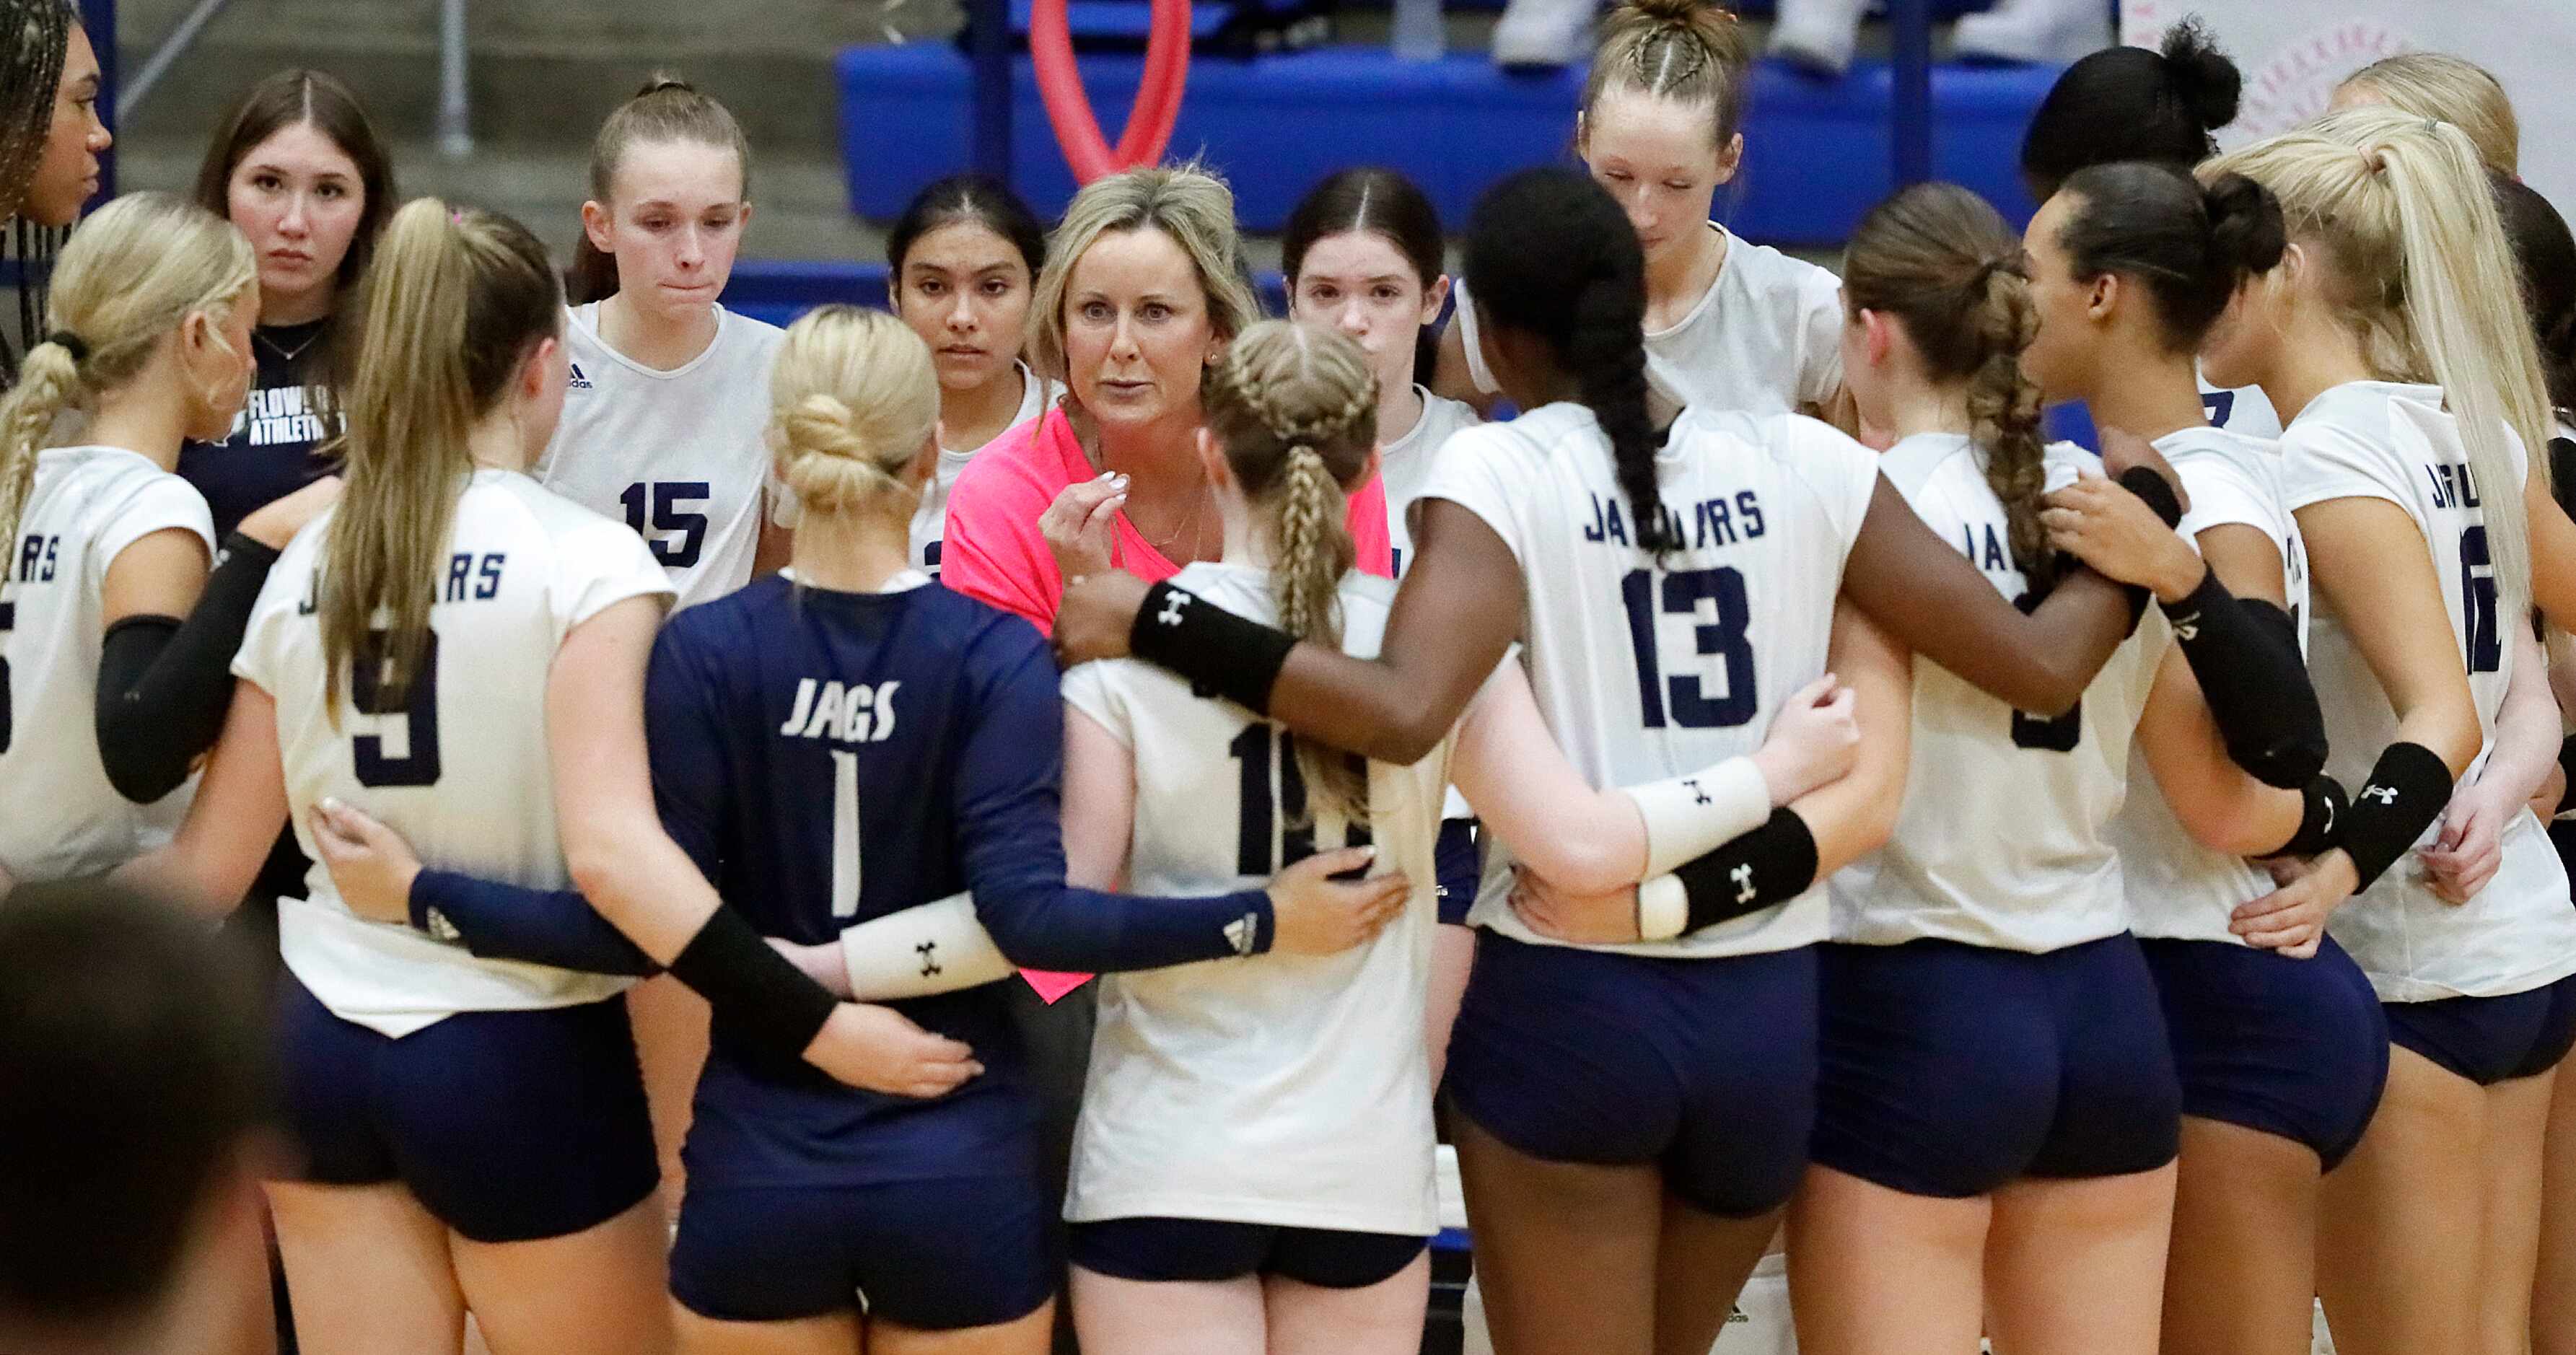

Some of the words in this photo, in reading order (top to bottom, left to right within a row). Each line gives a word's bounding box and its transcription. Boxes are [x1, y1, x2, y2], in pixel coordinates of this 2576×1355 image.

[249, 411, 347, 446] ATHLETI
[620, 482, 709, 568] 15
[1621, 566, 1758, 728] 13
[780, 678, 901, 743] JAGS
[830, 749, 862, 918] 1
